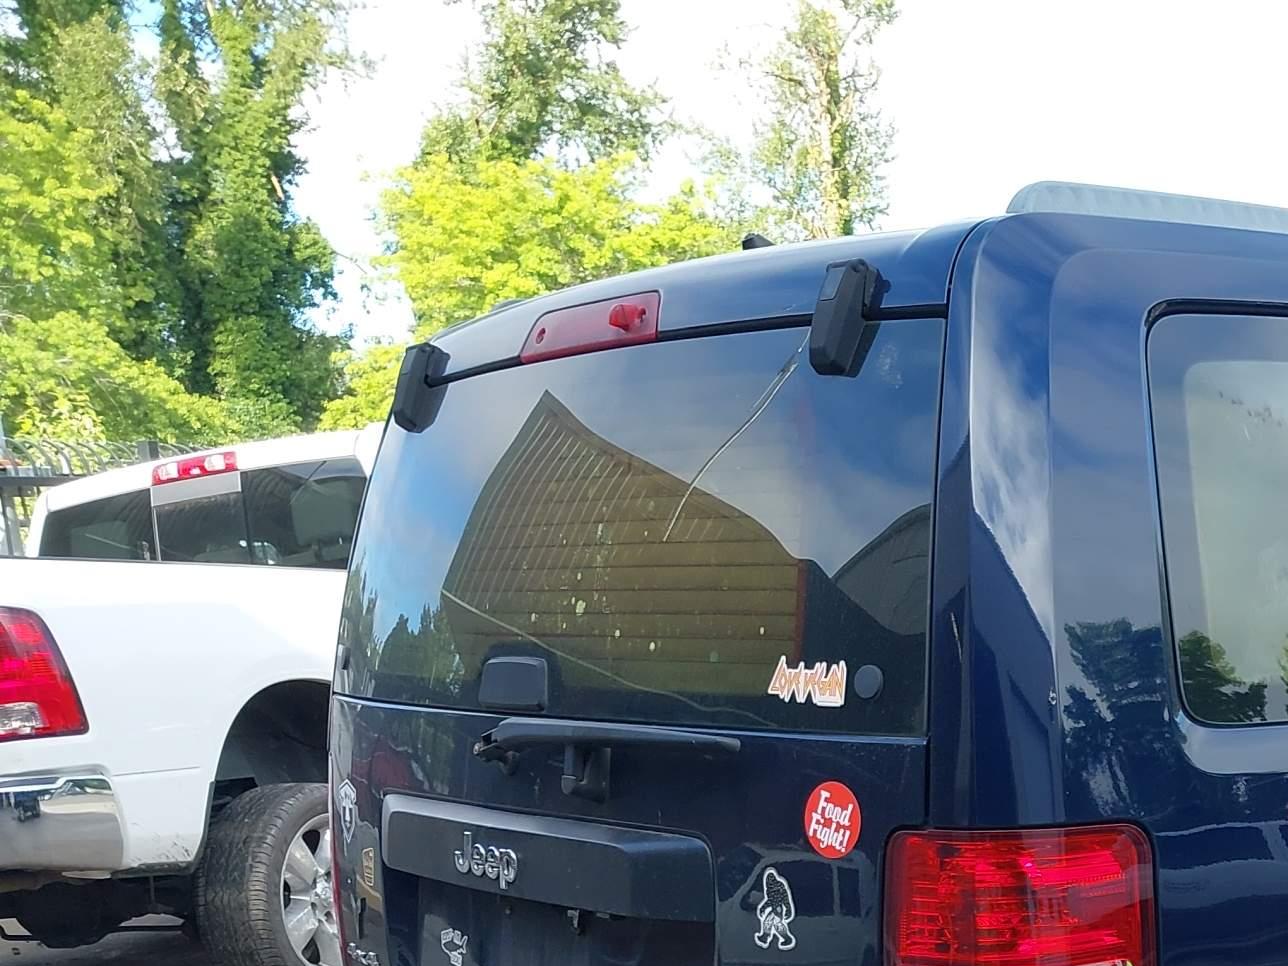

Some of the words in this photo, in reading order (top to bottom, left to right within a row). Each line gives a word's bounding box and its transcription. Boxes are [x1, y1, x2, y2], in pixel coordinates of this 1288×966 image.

[817, 789, 853, 826] Food
[809, 811, 851, 852] Fight!
[454, 831, 518, 889] Jeep
